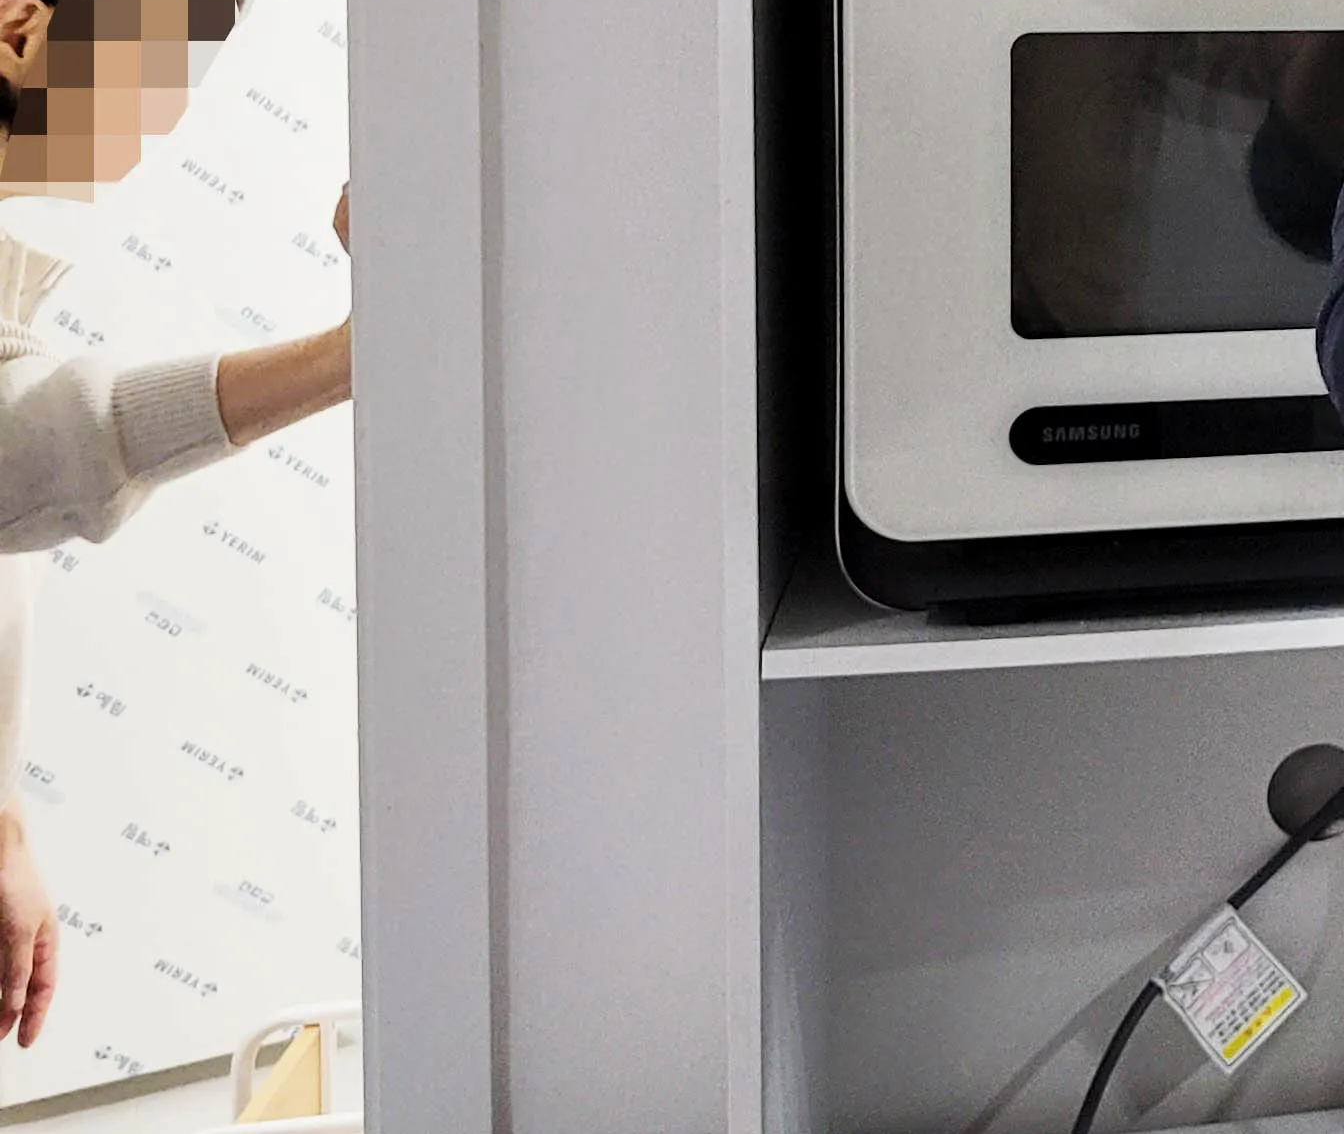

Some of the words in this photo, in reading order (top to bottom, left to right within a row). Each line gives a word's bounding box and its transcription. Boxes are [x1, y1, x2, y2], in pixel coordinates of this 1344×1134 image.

[245, 87, 290, 124] YERIM
[180, 158, 227, 195] YERIM
[1041, 423, 1141, 443] SAMSUNG
[284, 452, 331, 489] YERIM
[220, 529, 267, 566] YERIM
[245, 661, 290, 696] YERIM
[180, 739, 228, 774] YERIM
[153, 957, 201, 991] YERIM
